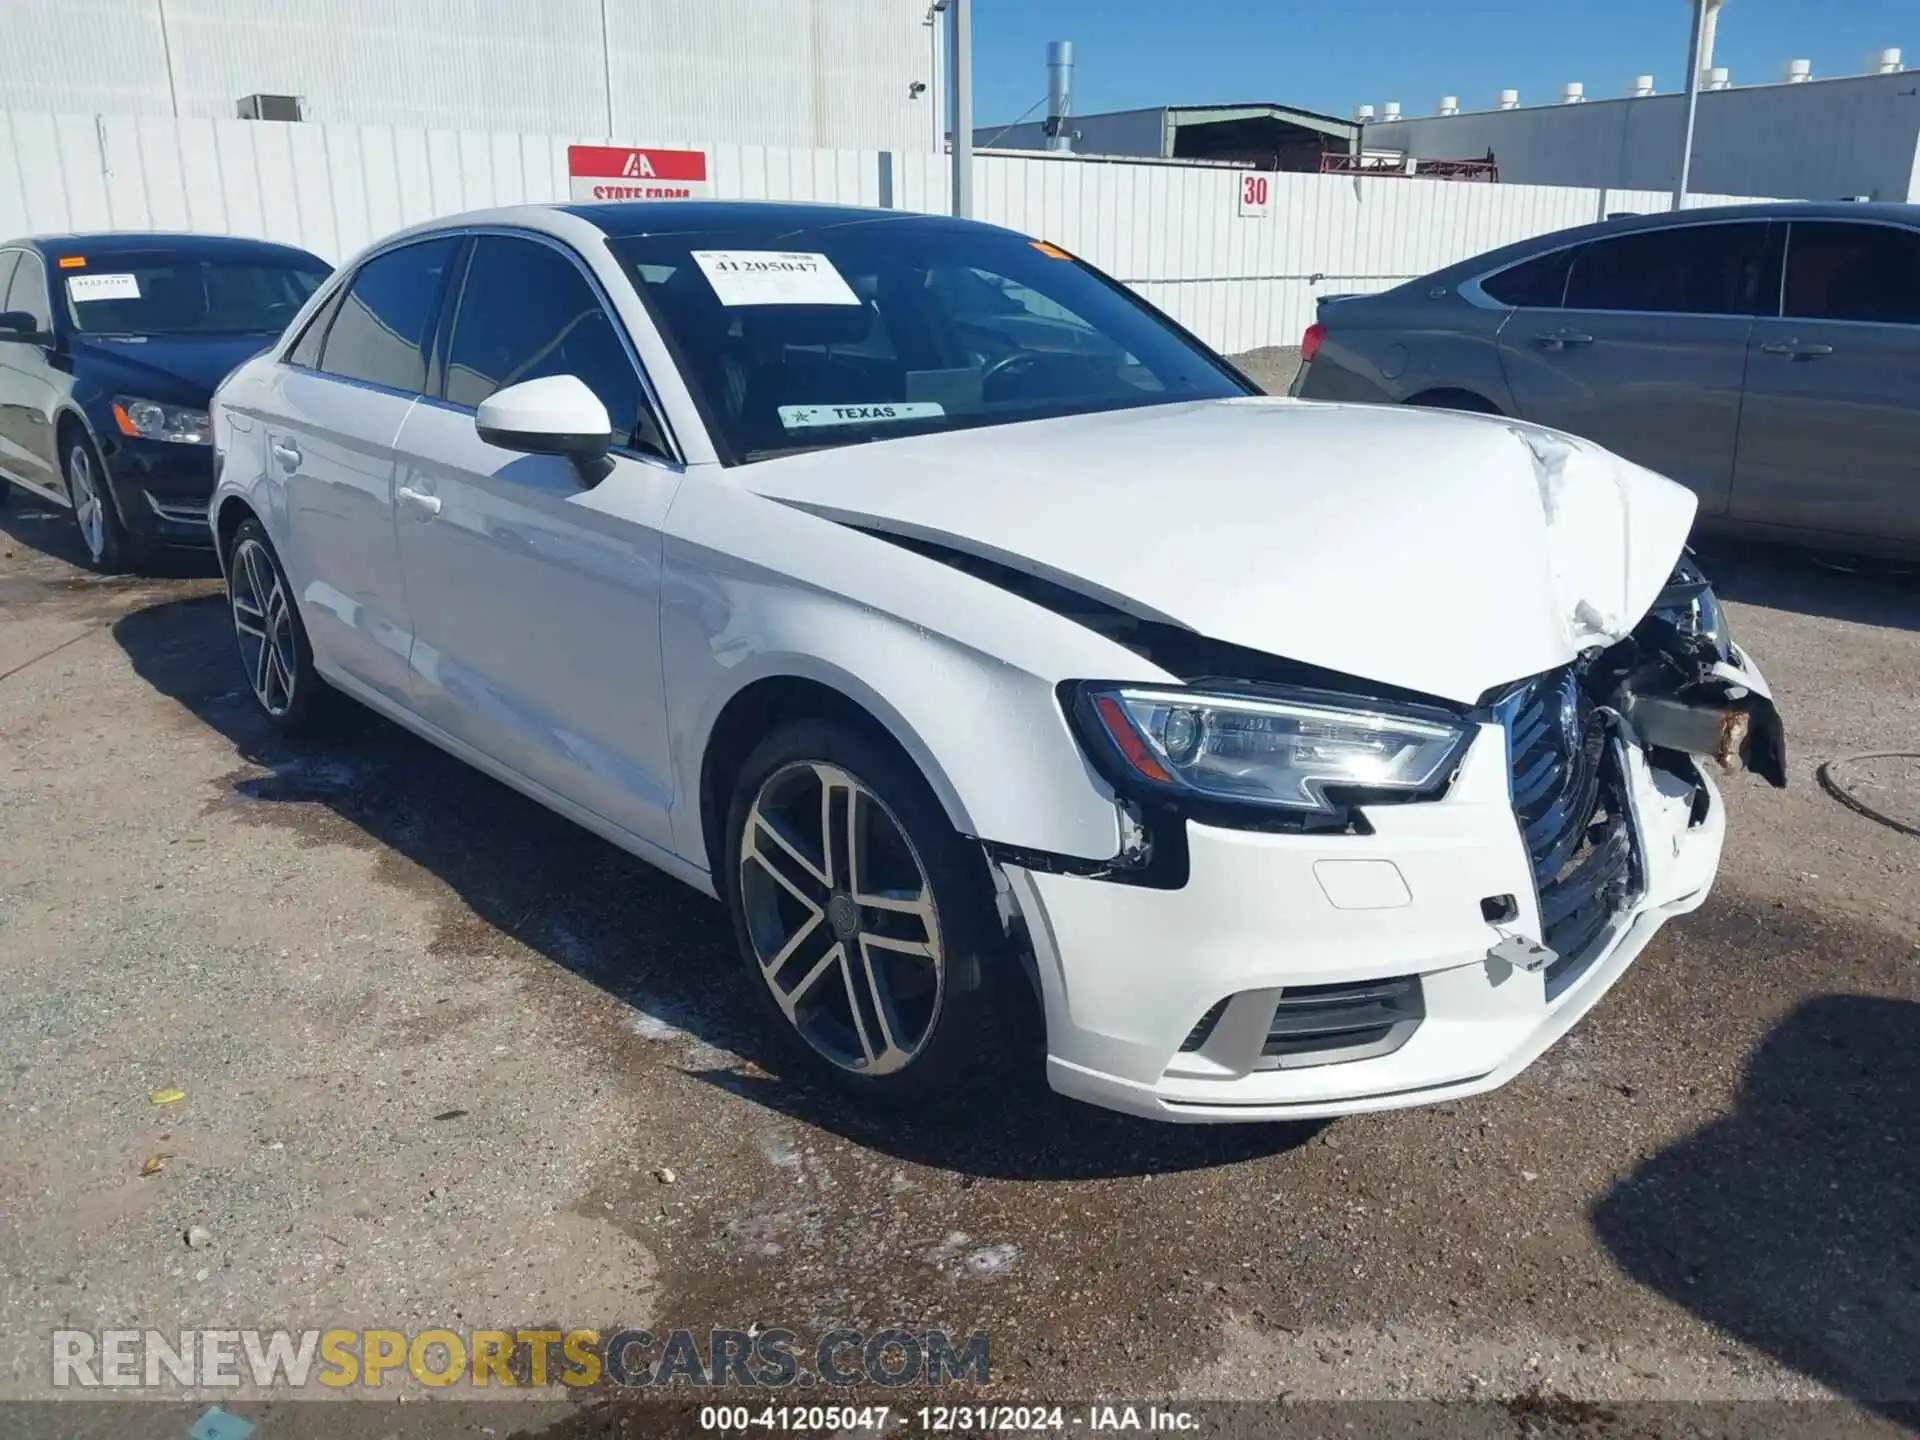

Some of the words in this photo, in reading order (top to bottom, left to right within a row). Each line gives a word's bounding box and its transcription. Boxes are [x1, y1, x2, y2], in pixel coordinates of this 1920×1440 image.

[1244, 176, 1267, 205] 30
[715, 260, 818, 273] 41205047
[832, 406, 897, 420] TEXAS
